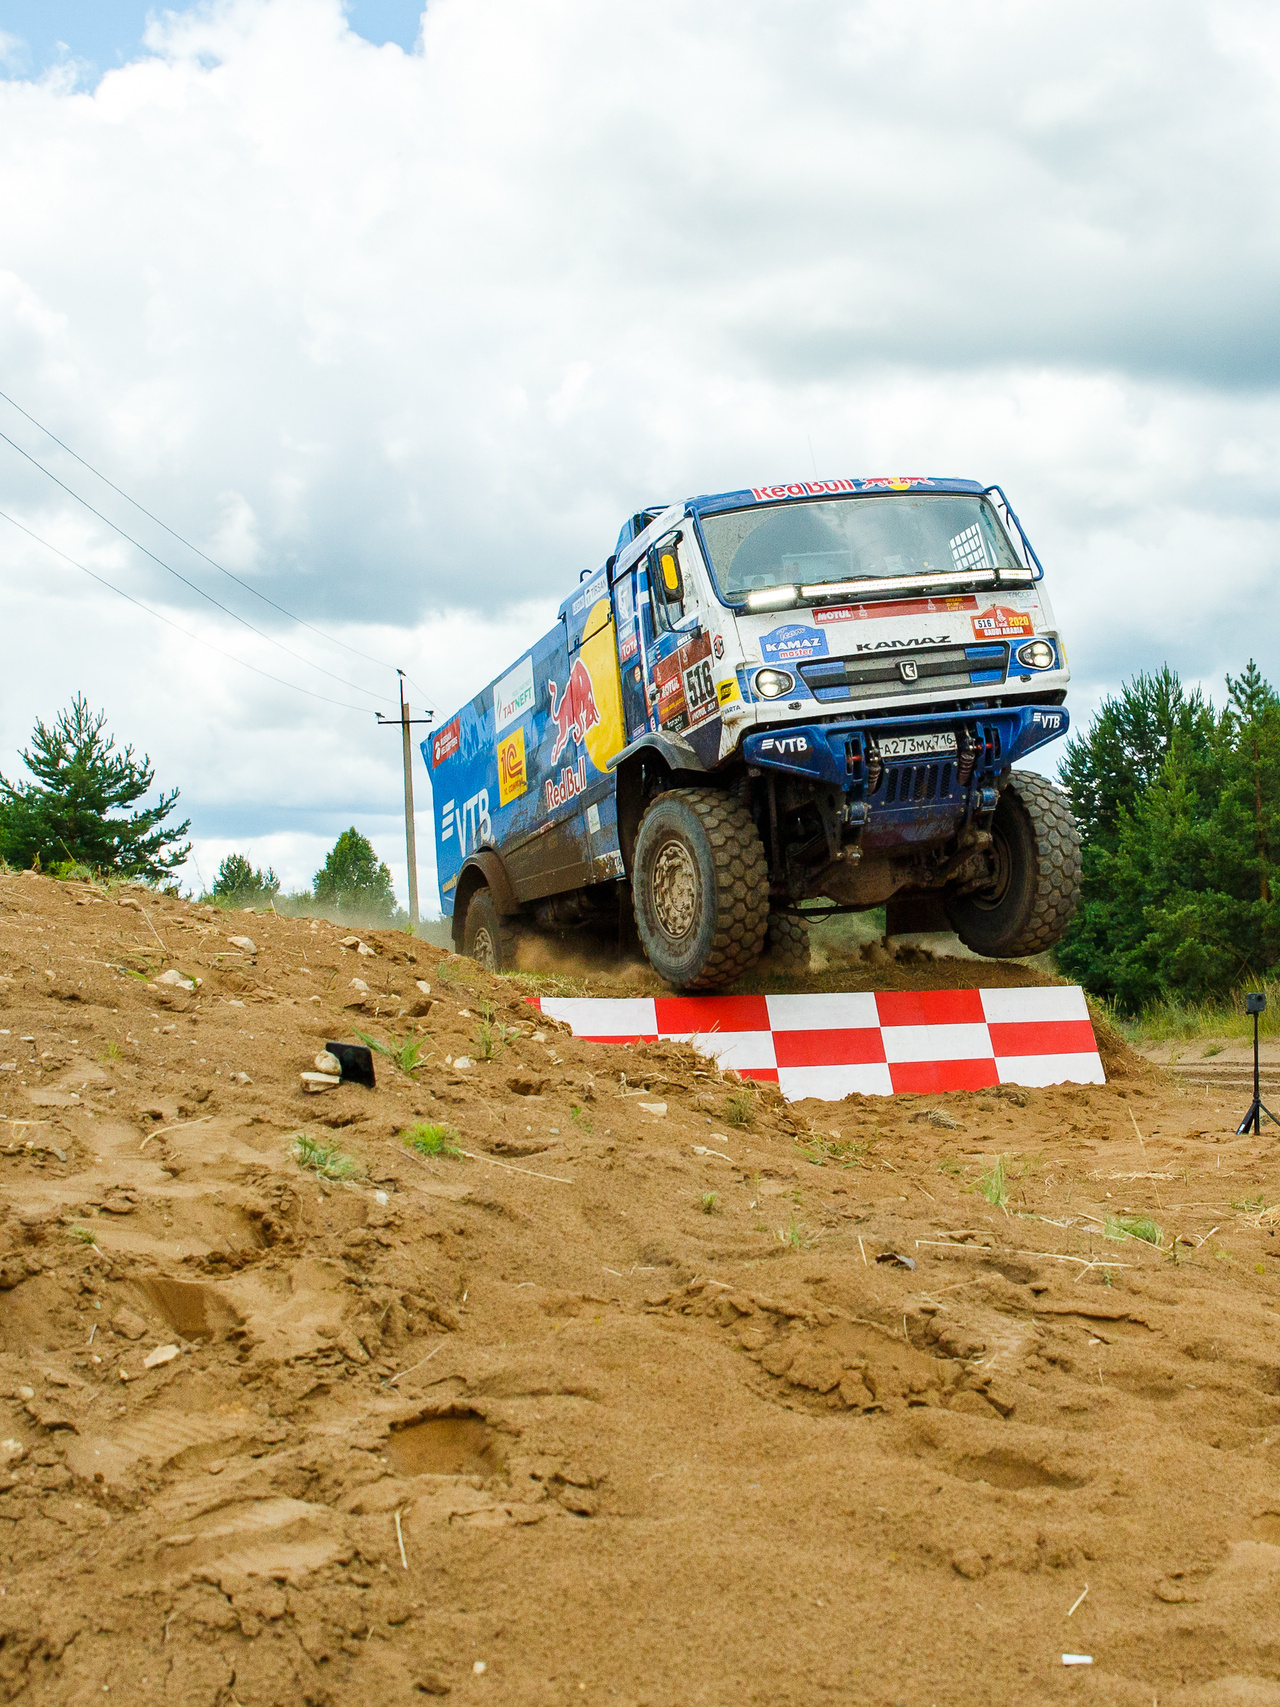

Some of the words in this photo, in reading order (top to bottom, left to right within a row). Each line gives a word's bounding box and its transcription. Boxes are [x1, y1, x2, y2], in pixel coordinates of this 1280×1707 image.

[752, 482, 805, 500] Red
[804, 479, 856, 495] Bull
[817, 609, 852, 621] MOTUL
[1008, 616, 1030, 627] 2020
[977, 619, 992, 628] 516
[776, 627, 805, 641] Team
[621, 638, 637, 657] TOTA
[765, 638, 822, 652] KAMAZ
[856, 635, 951, 652] KAMAZ
[780, 649, 813, 658] master
[686, 660, 715, 707] 516
[503, 687, 532, 719] TATNEFT
[724, 704, 741, 714] VARTA
[1041, 715, 1060, 729] VTB
[776, 736, 808, 754] VTB
[545, 768, 567, 811] Red
[567, 755, 586, 799] Bull
[455, 788, 492, 858] VTB
